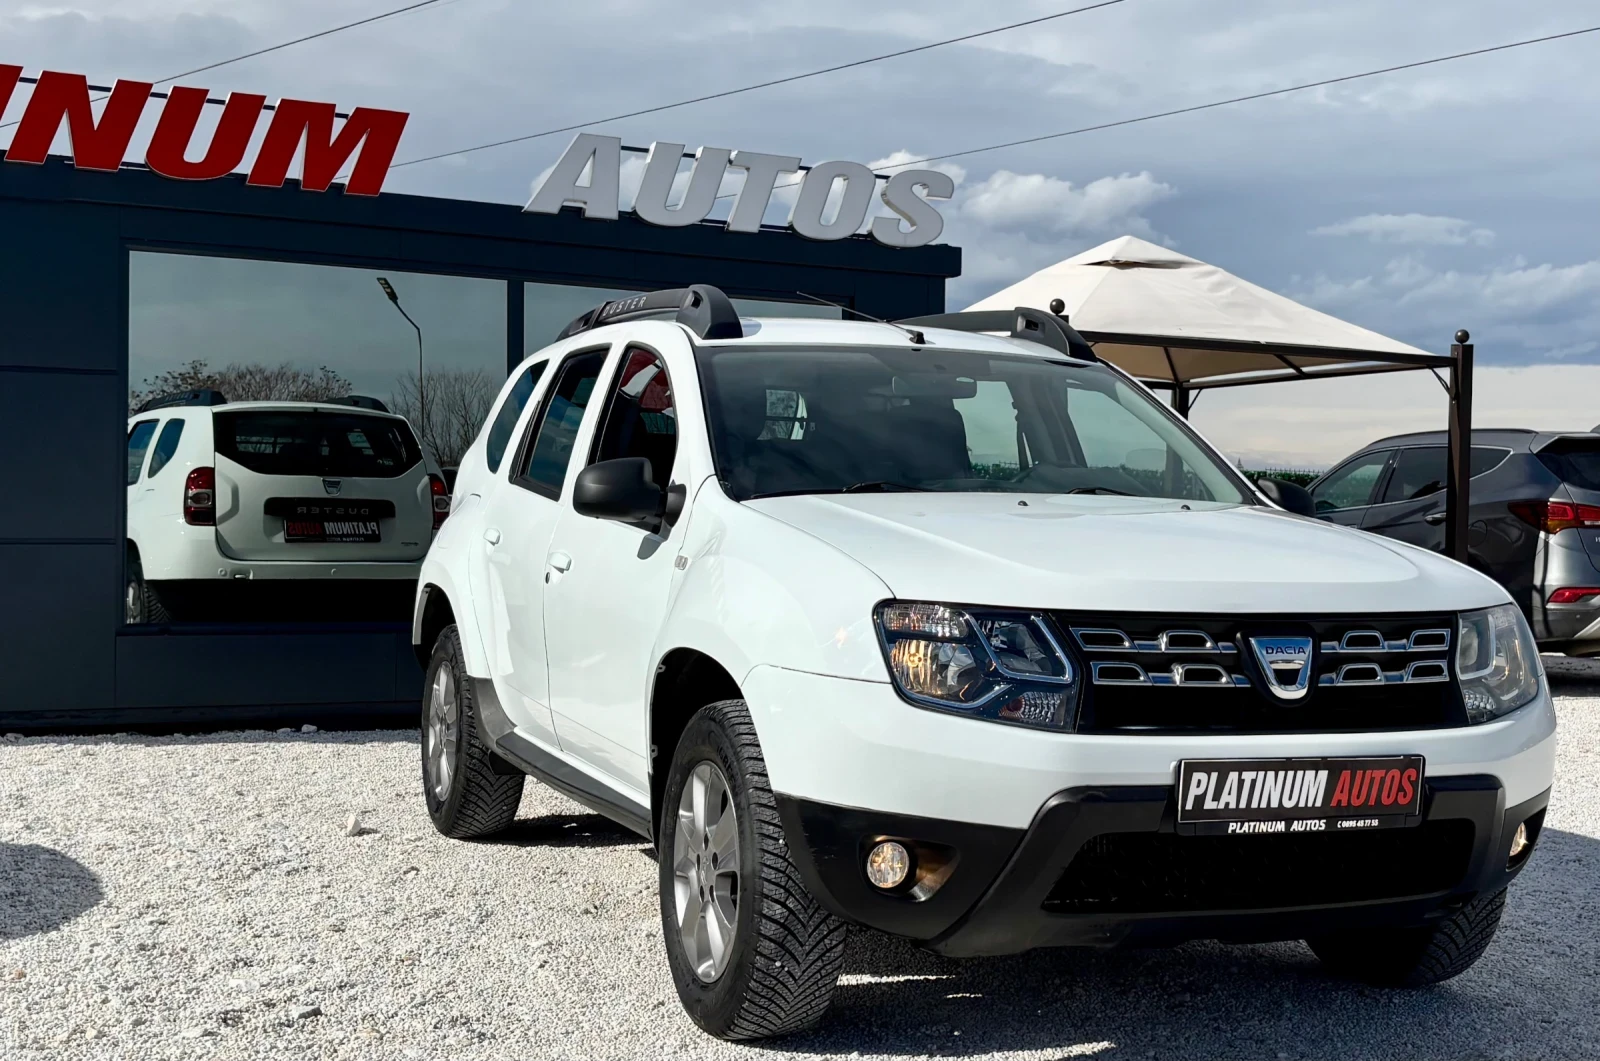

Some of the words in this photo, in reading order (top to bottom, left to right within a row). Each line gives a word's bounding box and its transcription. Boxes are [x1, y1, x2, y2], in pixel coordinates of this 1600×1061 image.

[0, 64, 410, 196] NUM
[522, 133, 955, 248] AUTOS
[602, 296, 647, 317] DUSTER
[1265, 646, 1306, 655] DACIA
[1185, 769, 1328, 811] PLATINUM
[1330, 768, 1417, 807] AUTOS
[1228, 821, 1286, 833] PLATINUM
[1290, 819, 1326, 832] AUTOS
